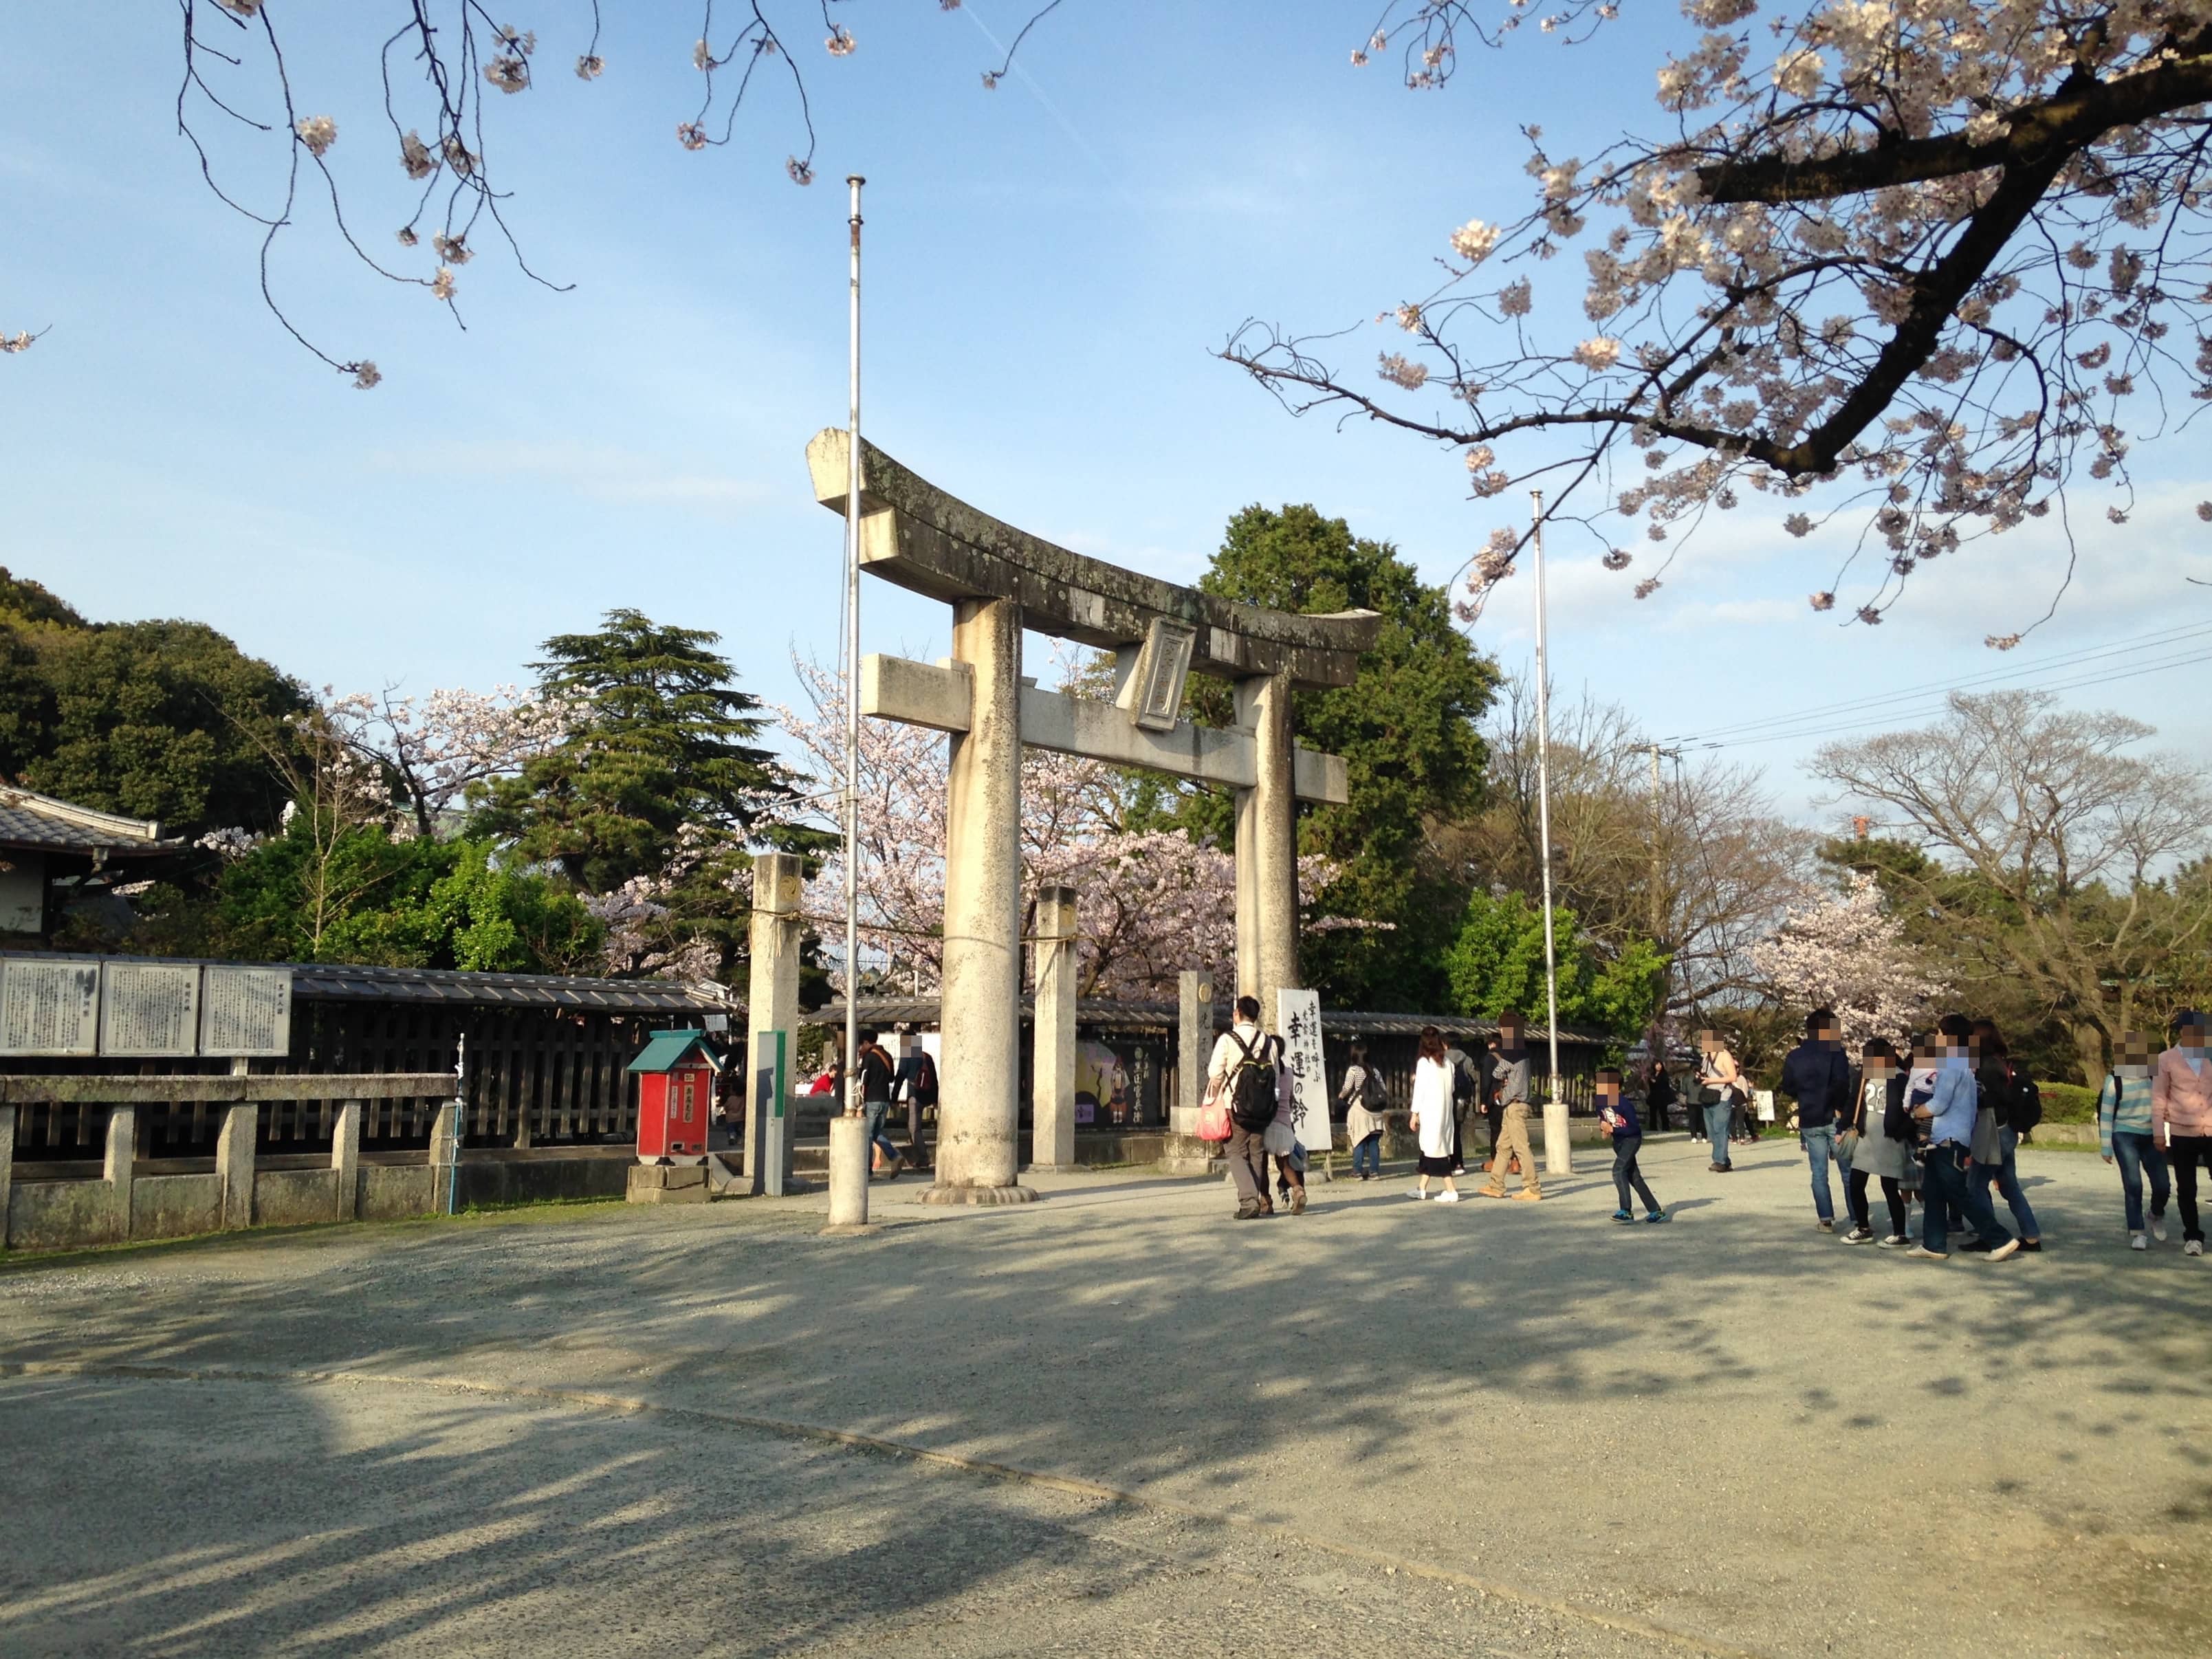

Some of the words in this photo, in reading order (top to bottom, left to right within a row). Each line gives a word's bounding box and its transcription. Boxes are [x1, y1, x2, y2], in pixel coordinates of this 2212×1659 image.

[1288, 1011, 1309, 1129] 幸運の鈴
[1308, 1000, 1321, 1083] 幸運を呼ぶ
